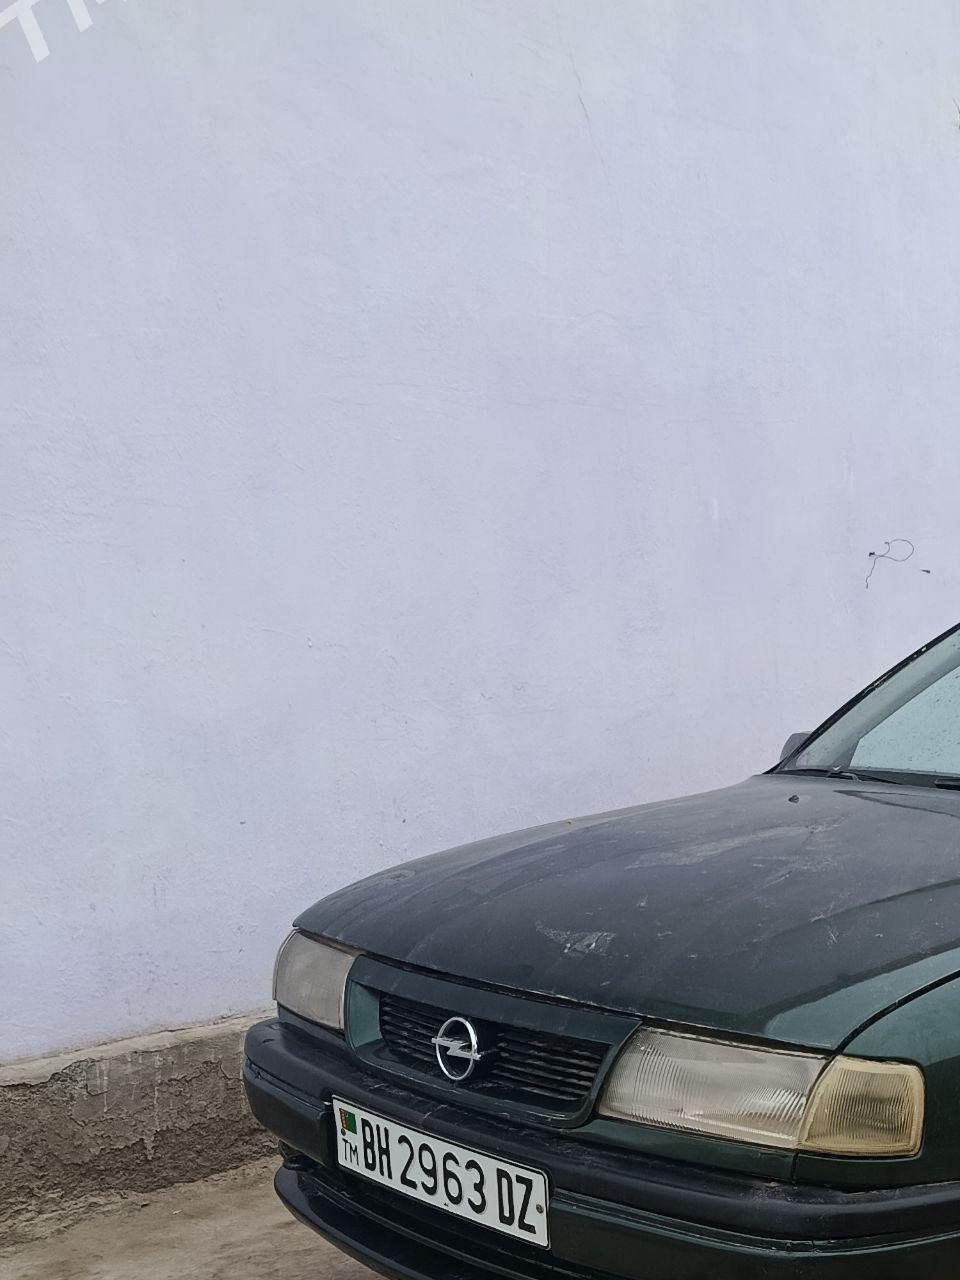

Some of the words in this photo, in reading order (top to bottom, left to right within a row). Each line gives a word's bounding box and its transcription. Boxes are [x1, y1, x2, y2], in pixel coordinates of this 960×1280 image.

[342, 1138, 359, 1166] TM
[361, 1117, 393, 1180] BH
[398, 1135, 487, 1214] 2963
[496, 1167, 537, 1235] DZ
